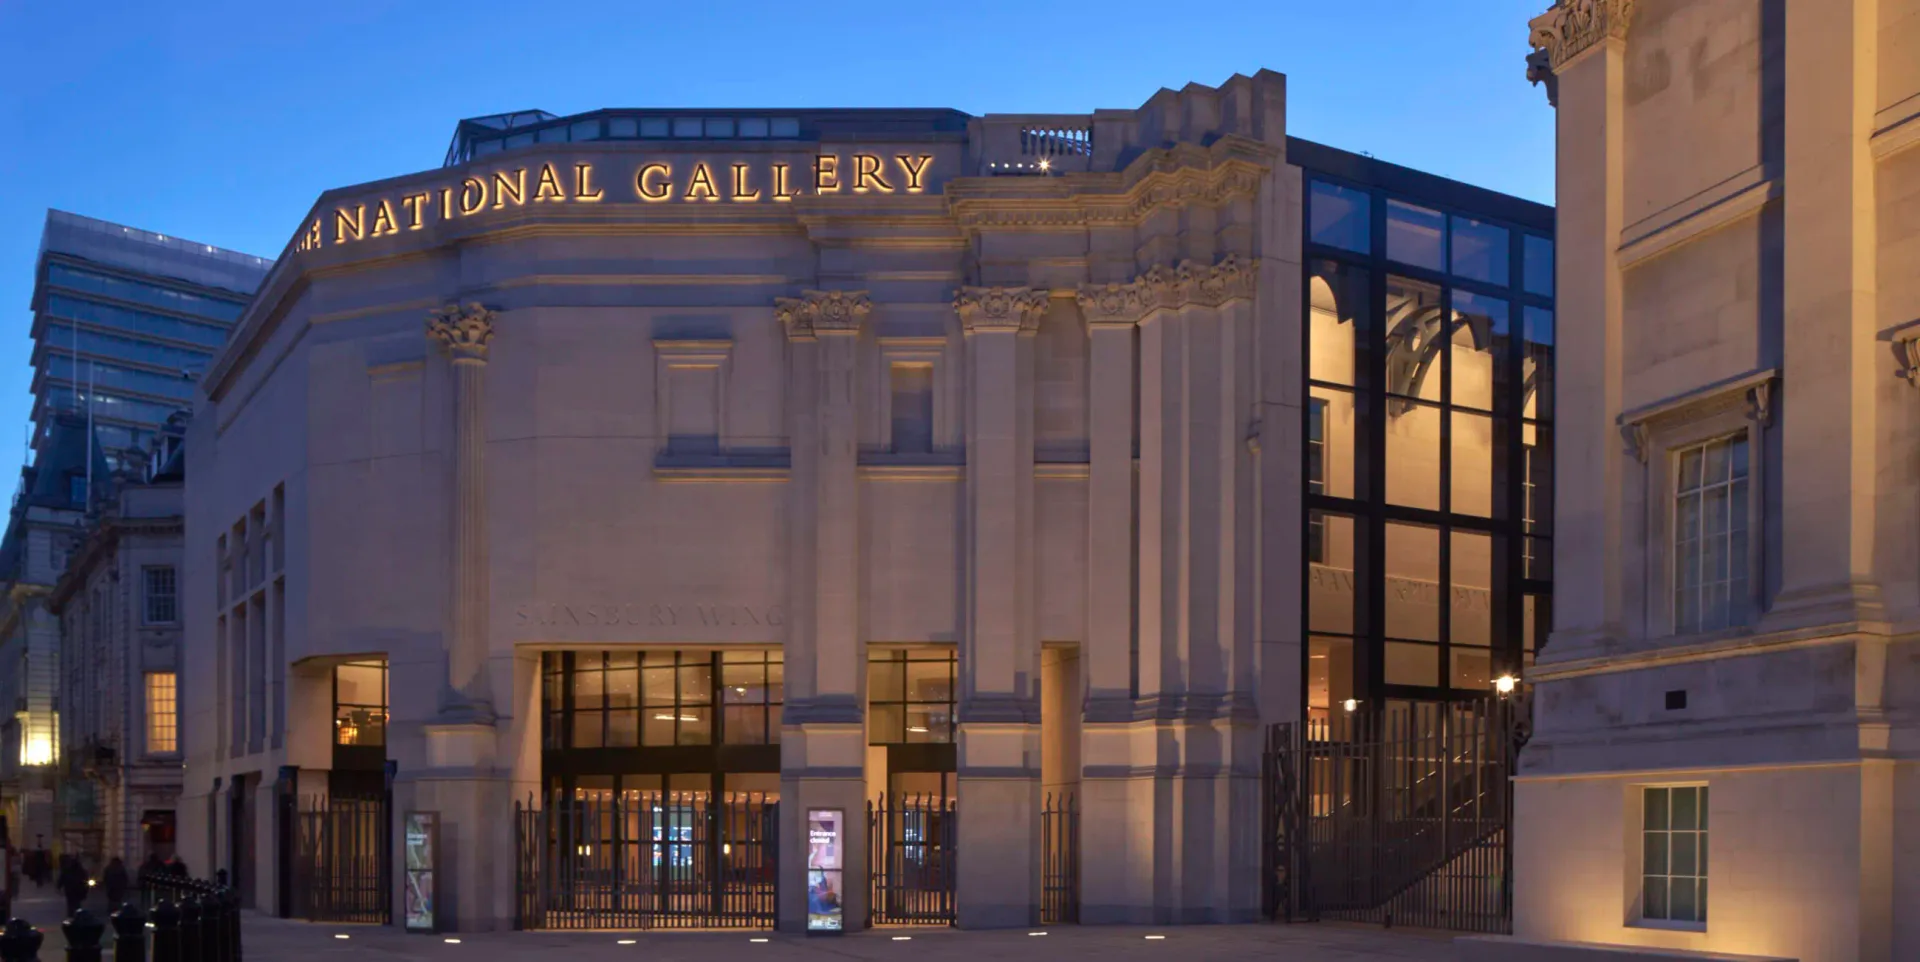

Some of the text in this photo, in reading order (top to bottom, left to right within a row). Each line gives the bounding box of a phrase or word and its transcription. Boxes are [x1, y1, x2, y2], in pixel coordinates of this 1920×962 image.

[334, 162, 605, 244] NATIONAL
[636, 154, 932, 200] GALLERY
[515, 602, 784, 627] SAINSBURY WING
